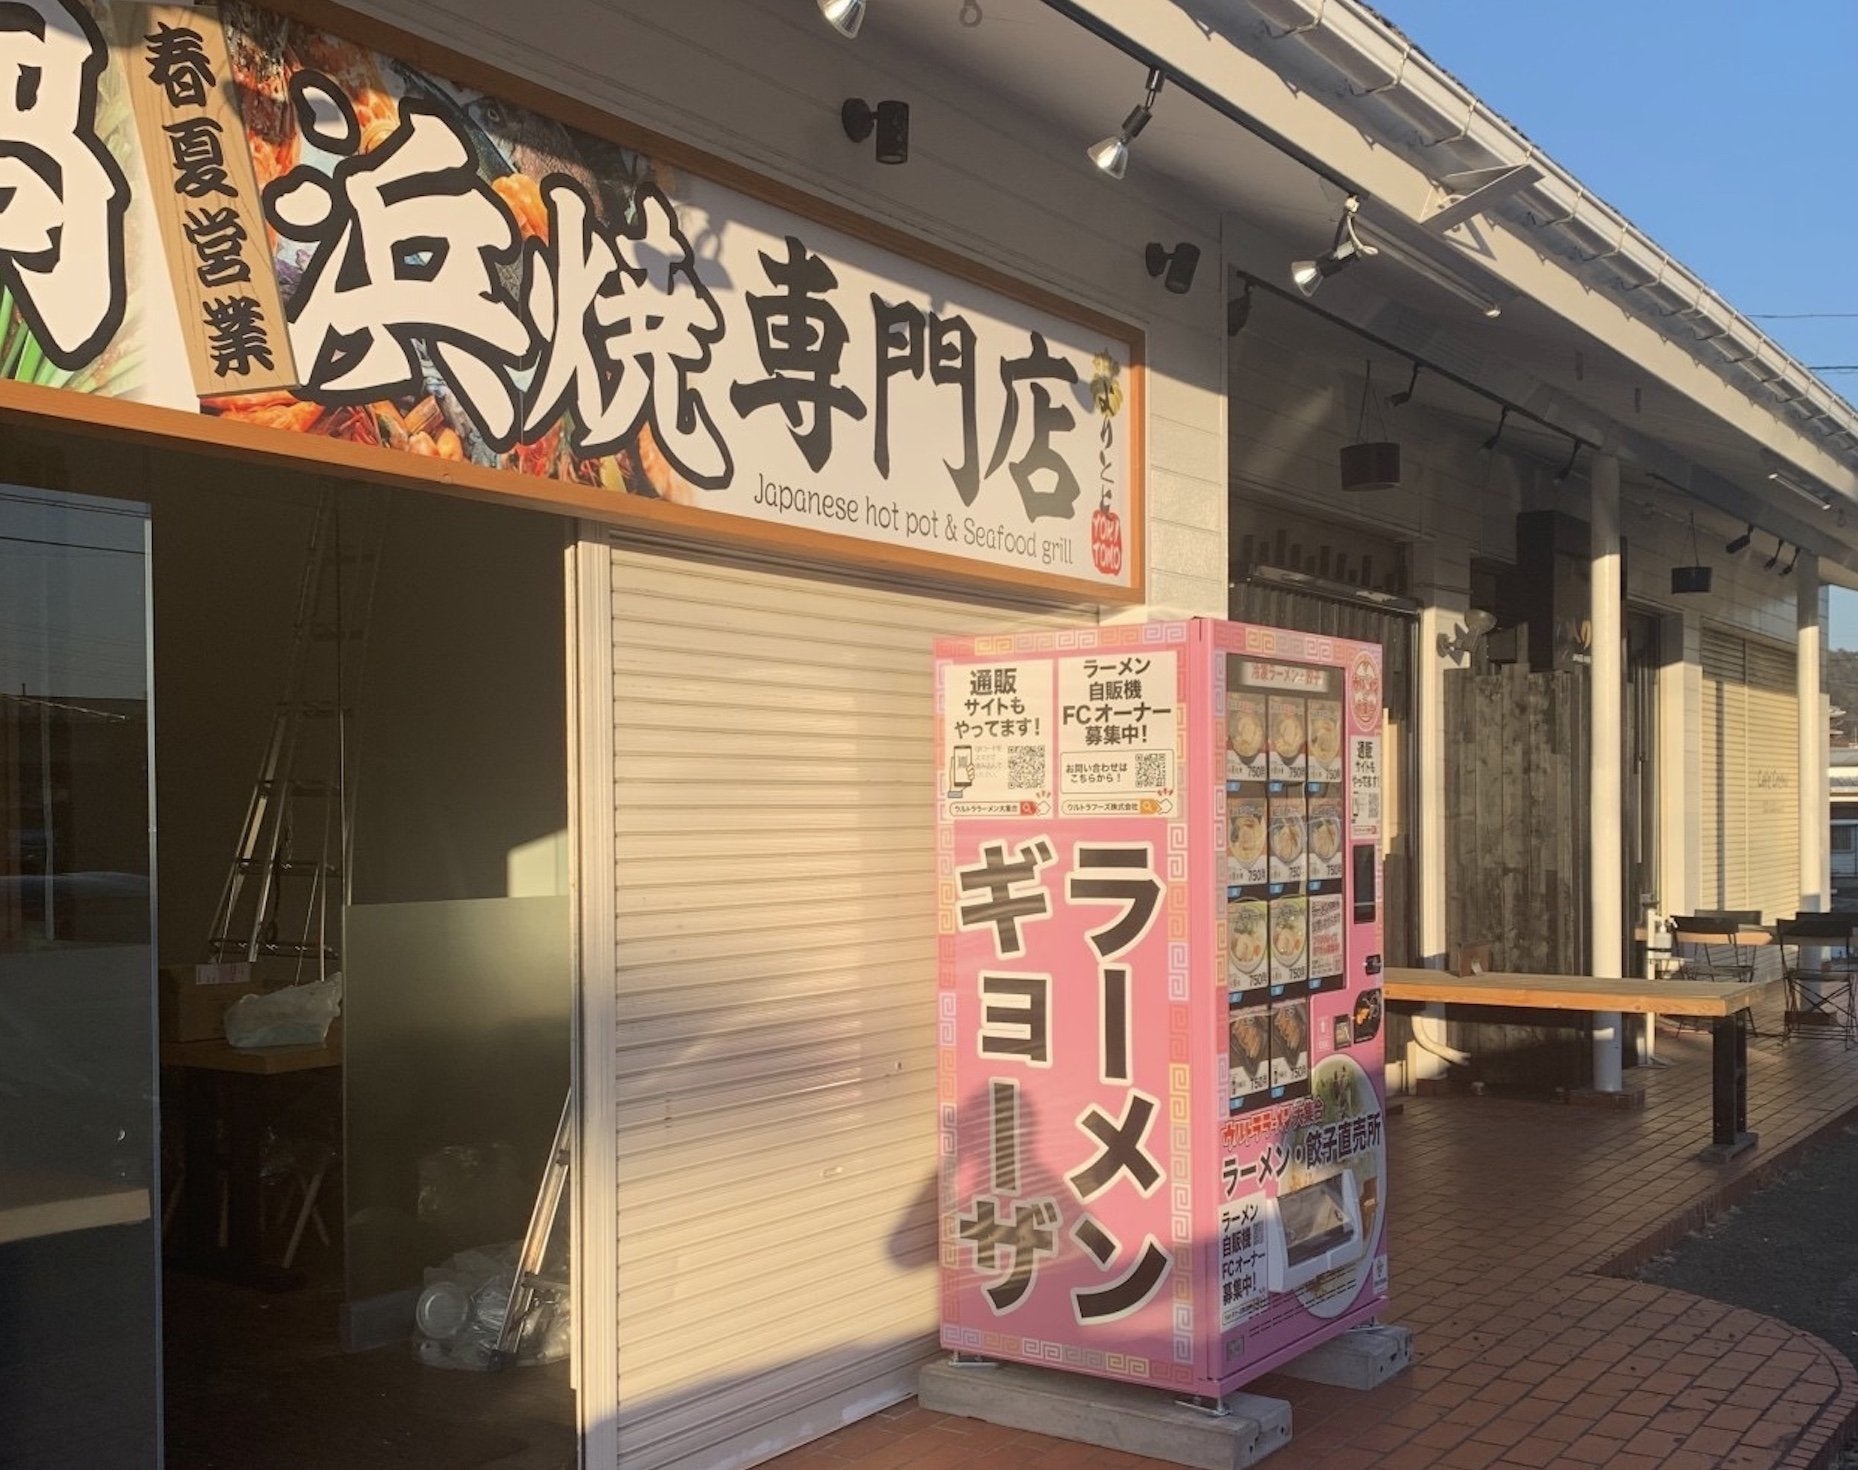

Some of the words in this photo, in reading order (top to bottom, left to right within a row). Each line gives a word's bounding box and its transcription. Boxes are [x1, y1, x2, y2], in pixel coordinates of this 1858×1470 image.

[144, 22, 274, 377] 春夏営業
[754, 473, 859, 523] Japanese
[866, 496, 899, 532] hot
[905, 508, 939, 541] pot
[945, 513, 958, 541] &
[964, 519, 1037, 558] Seafood
[1042, 531, 1073, 565] grill
[1083, 657, 1151, 678] ラーメン
[970, 668, 1017, 695] 通販
[1088, 679, 1142, 702] 自販機
[964, 697, 1025, 717] サイトも
[1062, 702, 1171, 725] FCオーナー
[1085, 725, 1147, 746] 募集中!
[1066, 763, 1128, 773] お問い合わせは
[957, 840, 1059, 1311] ギョーザ
[1070, 847, 1168, 1319] ラーメン
[1222, 1204, 1258, 1232] ラーメン
